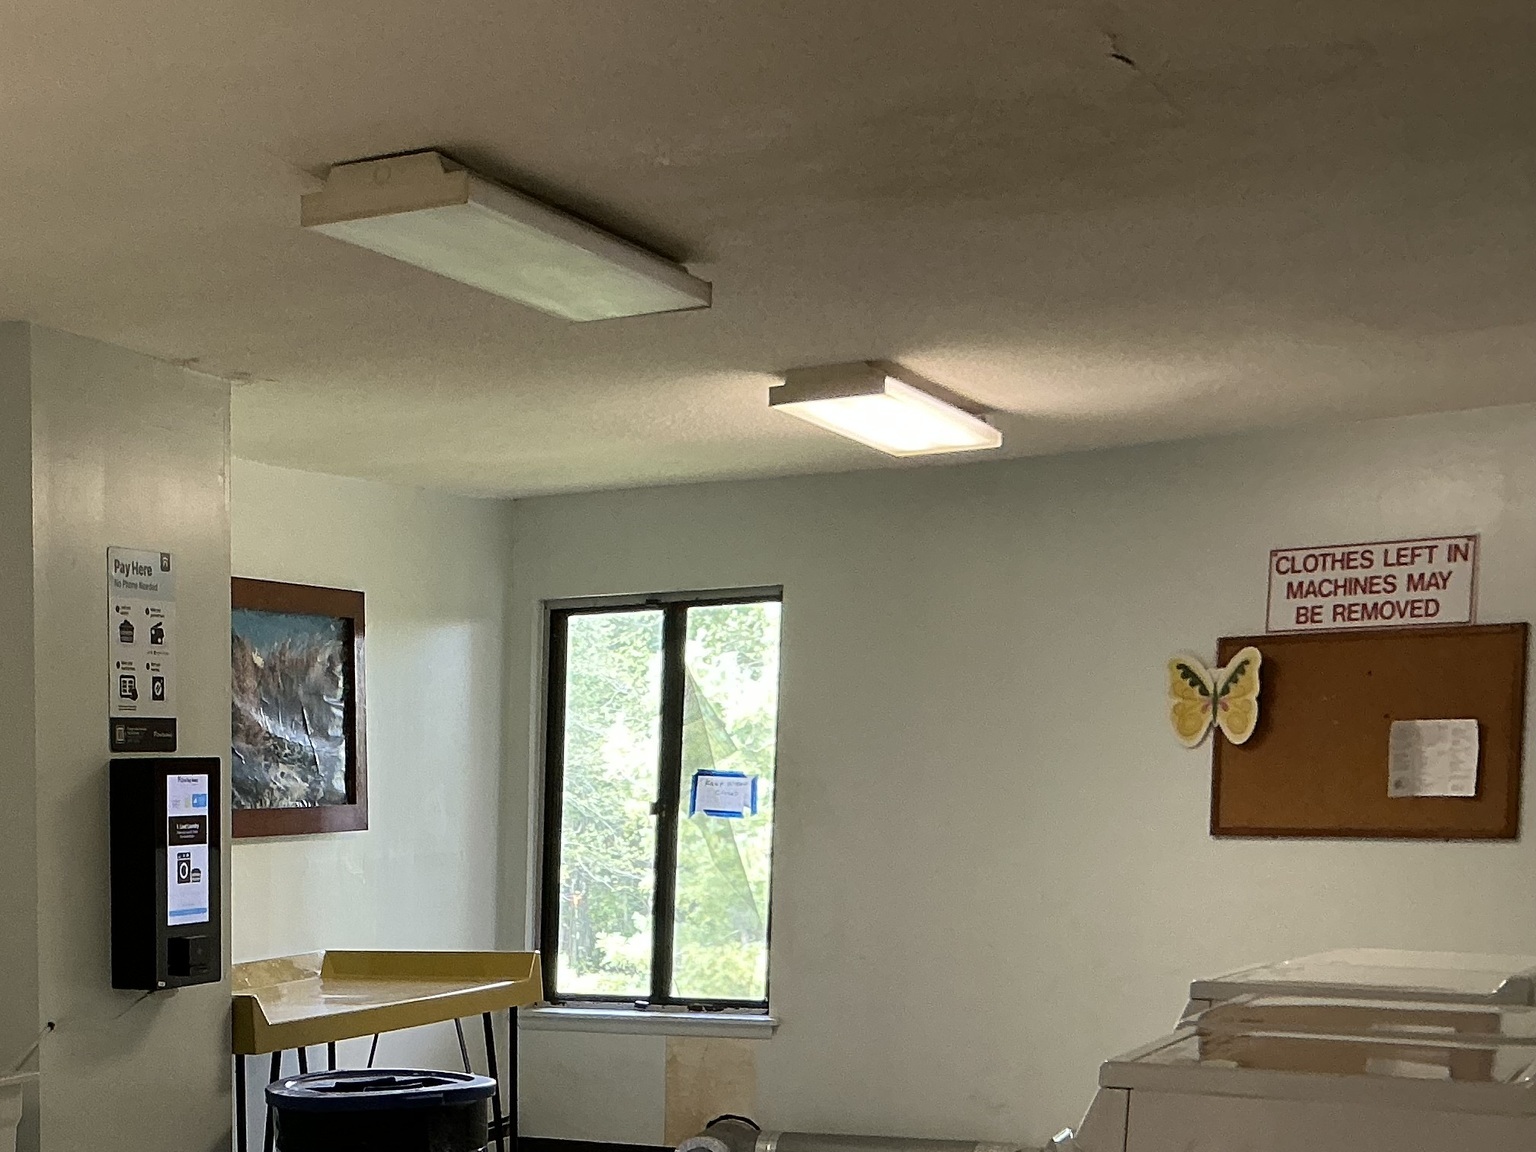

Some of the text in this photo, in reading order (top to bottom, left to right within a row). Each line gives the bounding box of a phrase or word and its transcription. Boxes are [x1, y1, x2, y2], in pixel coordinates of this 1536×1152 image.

[114, 559, 152, 577] Pay Here
[1275, 542, 1470, 576] CLOTHES LEFT IN
[1286, 570, 1453, 600] MACHINES MAY
[1295, 598, 1441, 625] BE REMOVED
